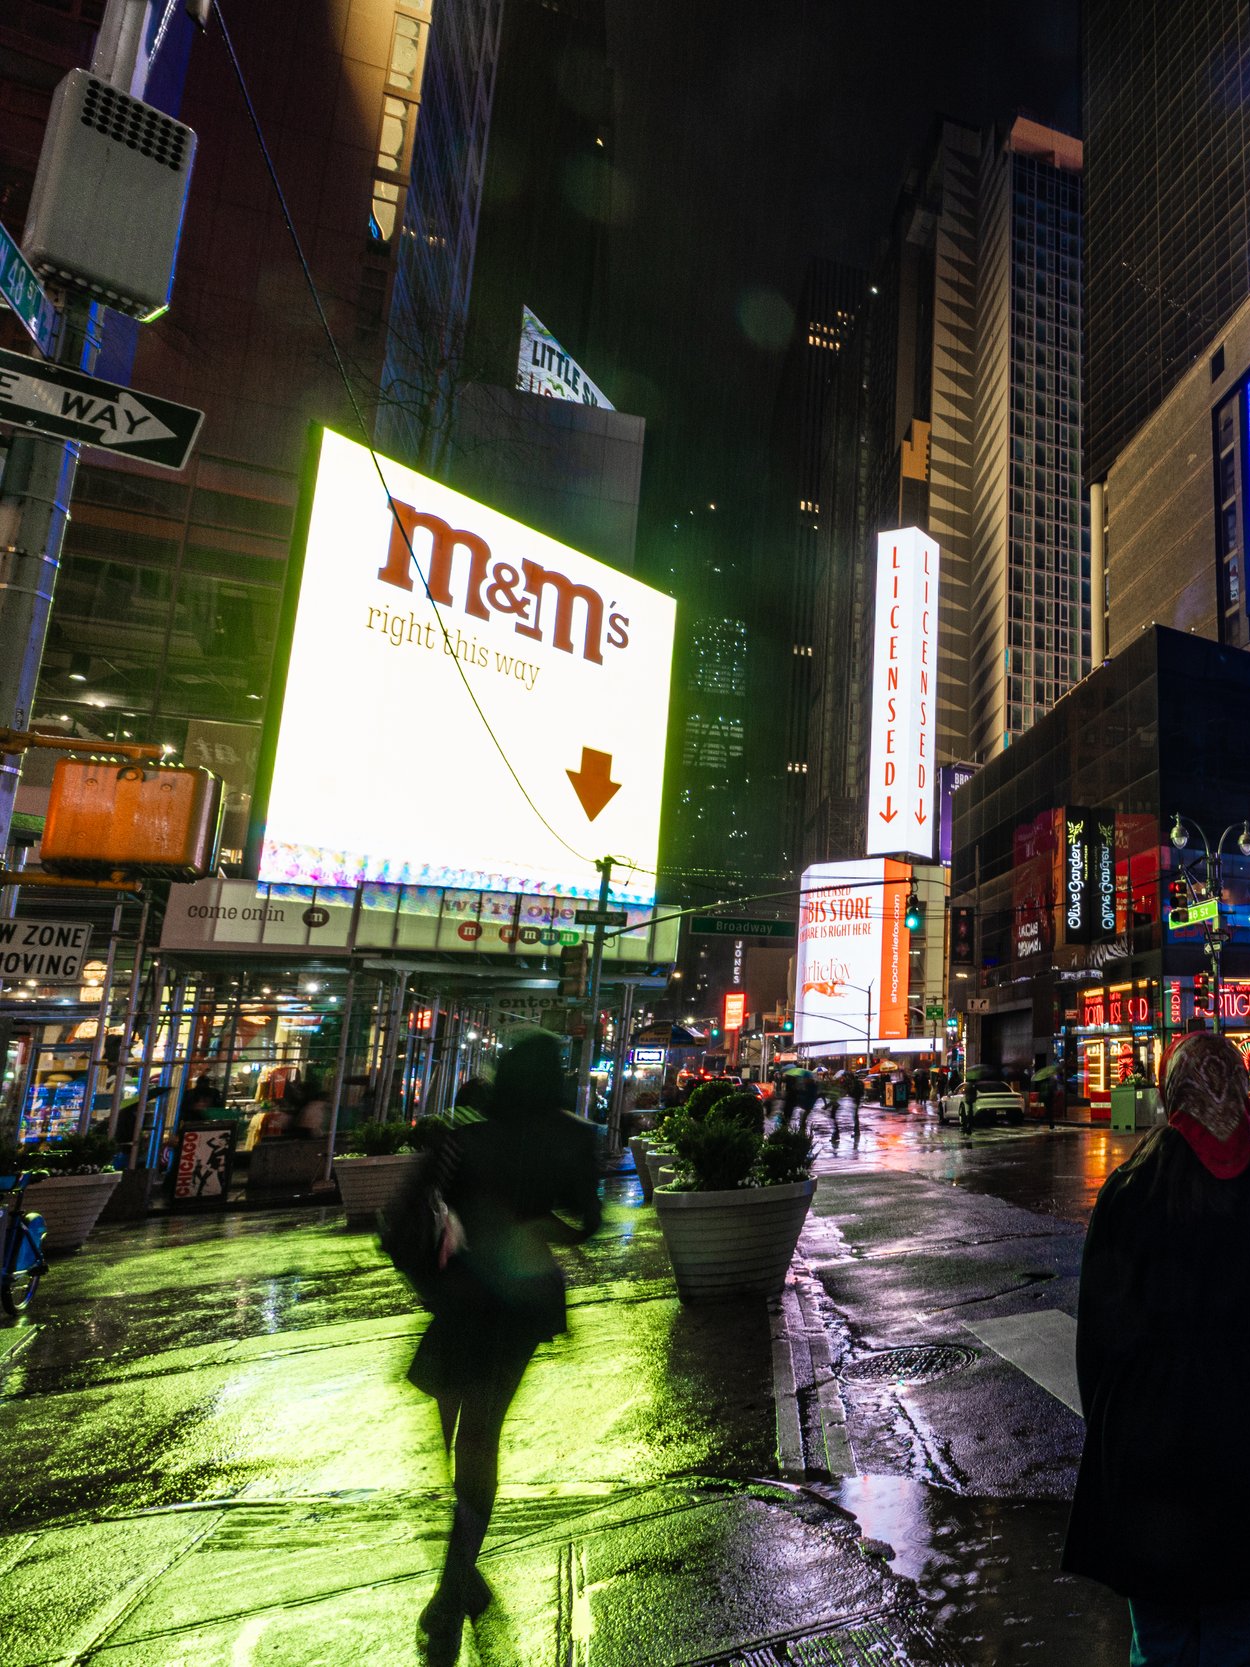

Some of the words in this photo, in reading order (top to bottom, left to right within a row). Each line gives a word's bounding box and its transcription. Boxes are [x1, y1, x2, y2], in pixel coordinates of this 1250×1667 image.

[8, 258, 26, 305] 48
[531, 340, 581, 396] LITTLE
[60, 391, 152, 436] WAY
[366, 603, 436, 650] right
[443, 627, 489, 668] this
[496, 651, 541, 691] way
[883, 544, 900, 788] LICENSED
[916, 549, 930, 790] LICENSED
[1068, 841, 1085, 893] Garden
[187, 904, 238, 920] come
[241, 906, 264, 921] on
[265, 905, 286, 922] in
[527, 906, 575, 923] ope
[716, 920, 773, 936] Broadway
[829, 896, 874, 922] STORE
[1068, 893, 1082, 929] Olive
[1200, 906, 1209, 917] St
[22, 925, 85, 948] ZONE
[523, 929, 537, 940] m
[820, 925, 827, 938] IS
[828, 923, 851, 937] RIGHT
[852, 922, 873, 936] HERE
[890, 894, 901, 1004] shopcharliefox.com
[0, 952, 77, 976] OVING
[732, 940, 743, 985] JONES
[176, 1132, 199, 1197] CHICAGO
